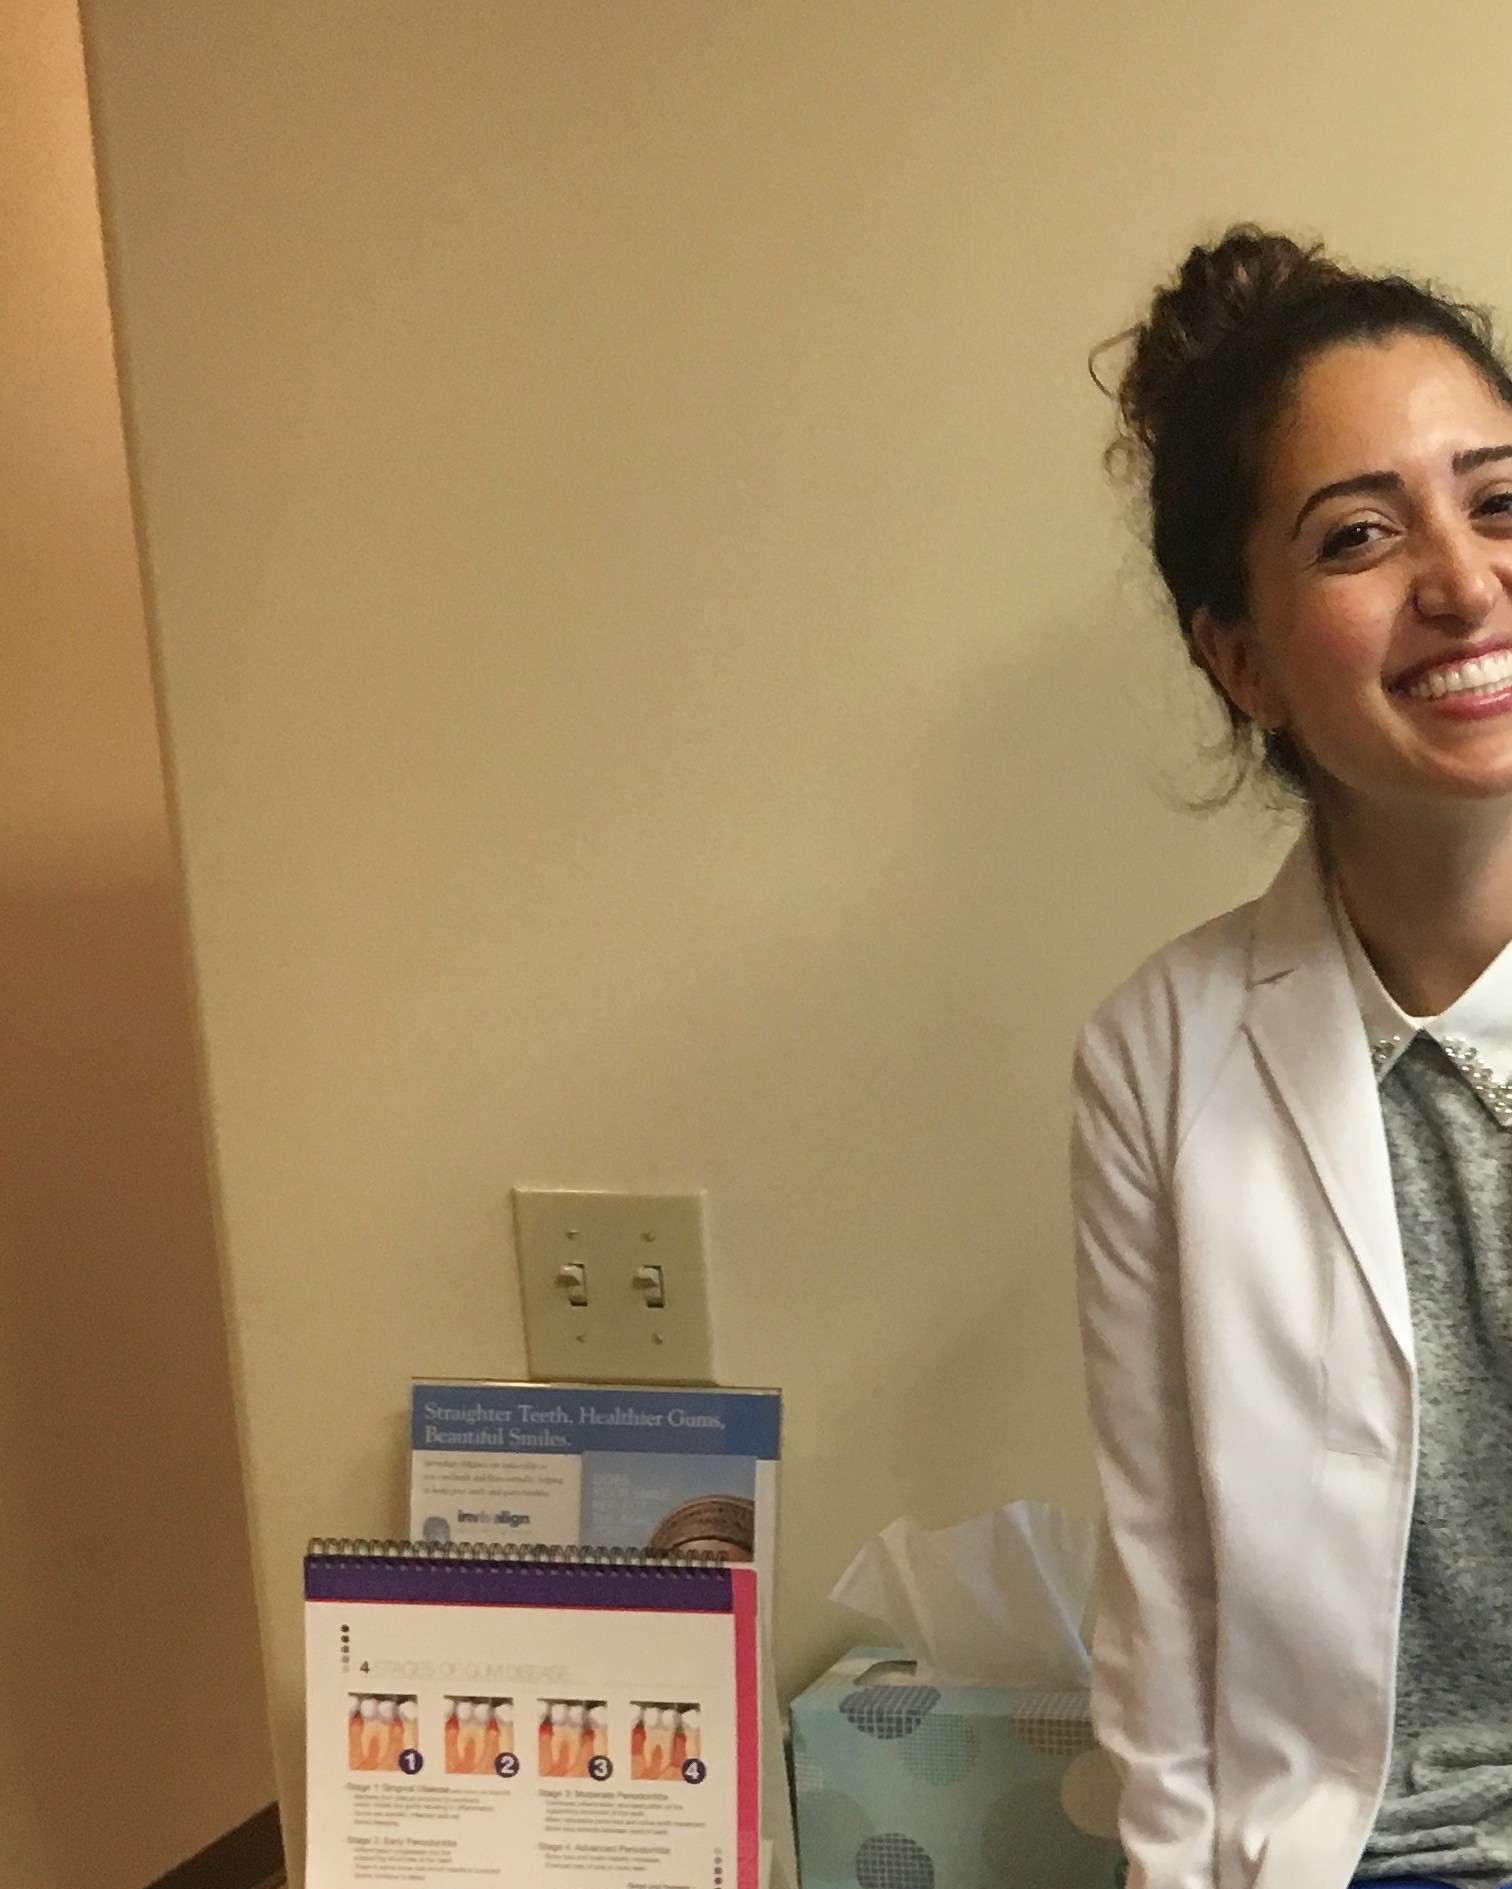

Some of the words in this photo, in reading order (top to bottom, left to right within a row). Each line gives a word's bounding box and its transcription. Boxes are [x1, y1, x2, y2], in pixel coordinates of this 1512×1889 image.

[424, 1402, 512, 1424] Straighter
[518, 1404, 574, 1425] Teeth,
[579, 1406, 663, 1426] Healthier
[667, 1408, 726, 1430] Gums,
[425, 1425, 504, 1446] Beautiful
[509, 1427, 573, 1447] Smiles.
[359, 1661, 371, 1674] 4
[404, 1753, 416, 1771] 1
[500, 1755, 515, 1774] 2
[593, 1758, 608, 1777] 3
[685, 1761, 700, 1779] 4
